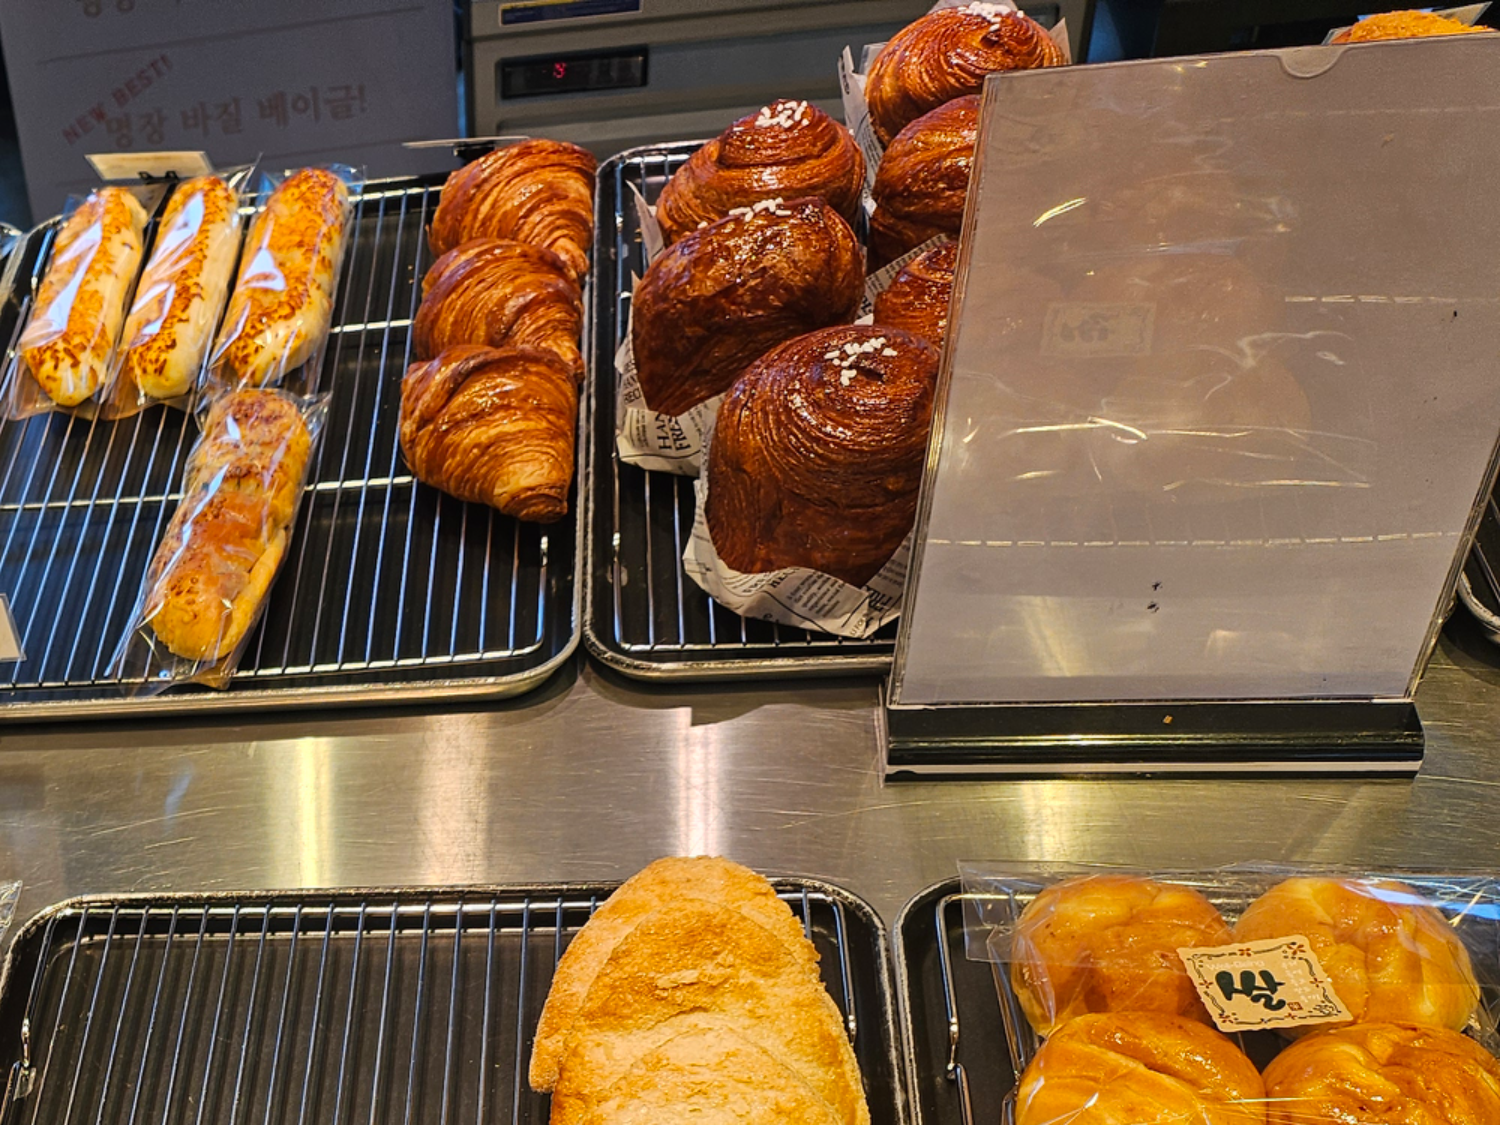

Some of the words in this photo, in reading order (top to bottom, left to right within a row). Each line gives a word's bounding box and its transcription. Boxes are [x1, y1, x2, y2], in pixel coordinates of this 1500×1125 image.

[62, 103, 108, 145] NEW
[112, 53, 173, 107] BEST!
[105, 107, 170, 149] 명장
[181, 96, 243, 138] 바질
[257, 84, 368, 130] 베이글!
[1215, 970, 1286, 1011] 쌀
